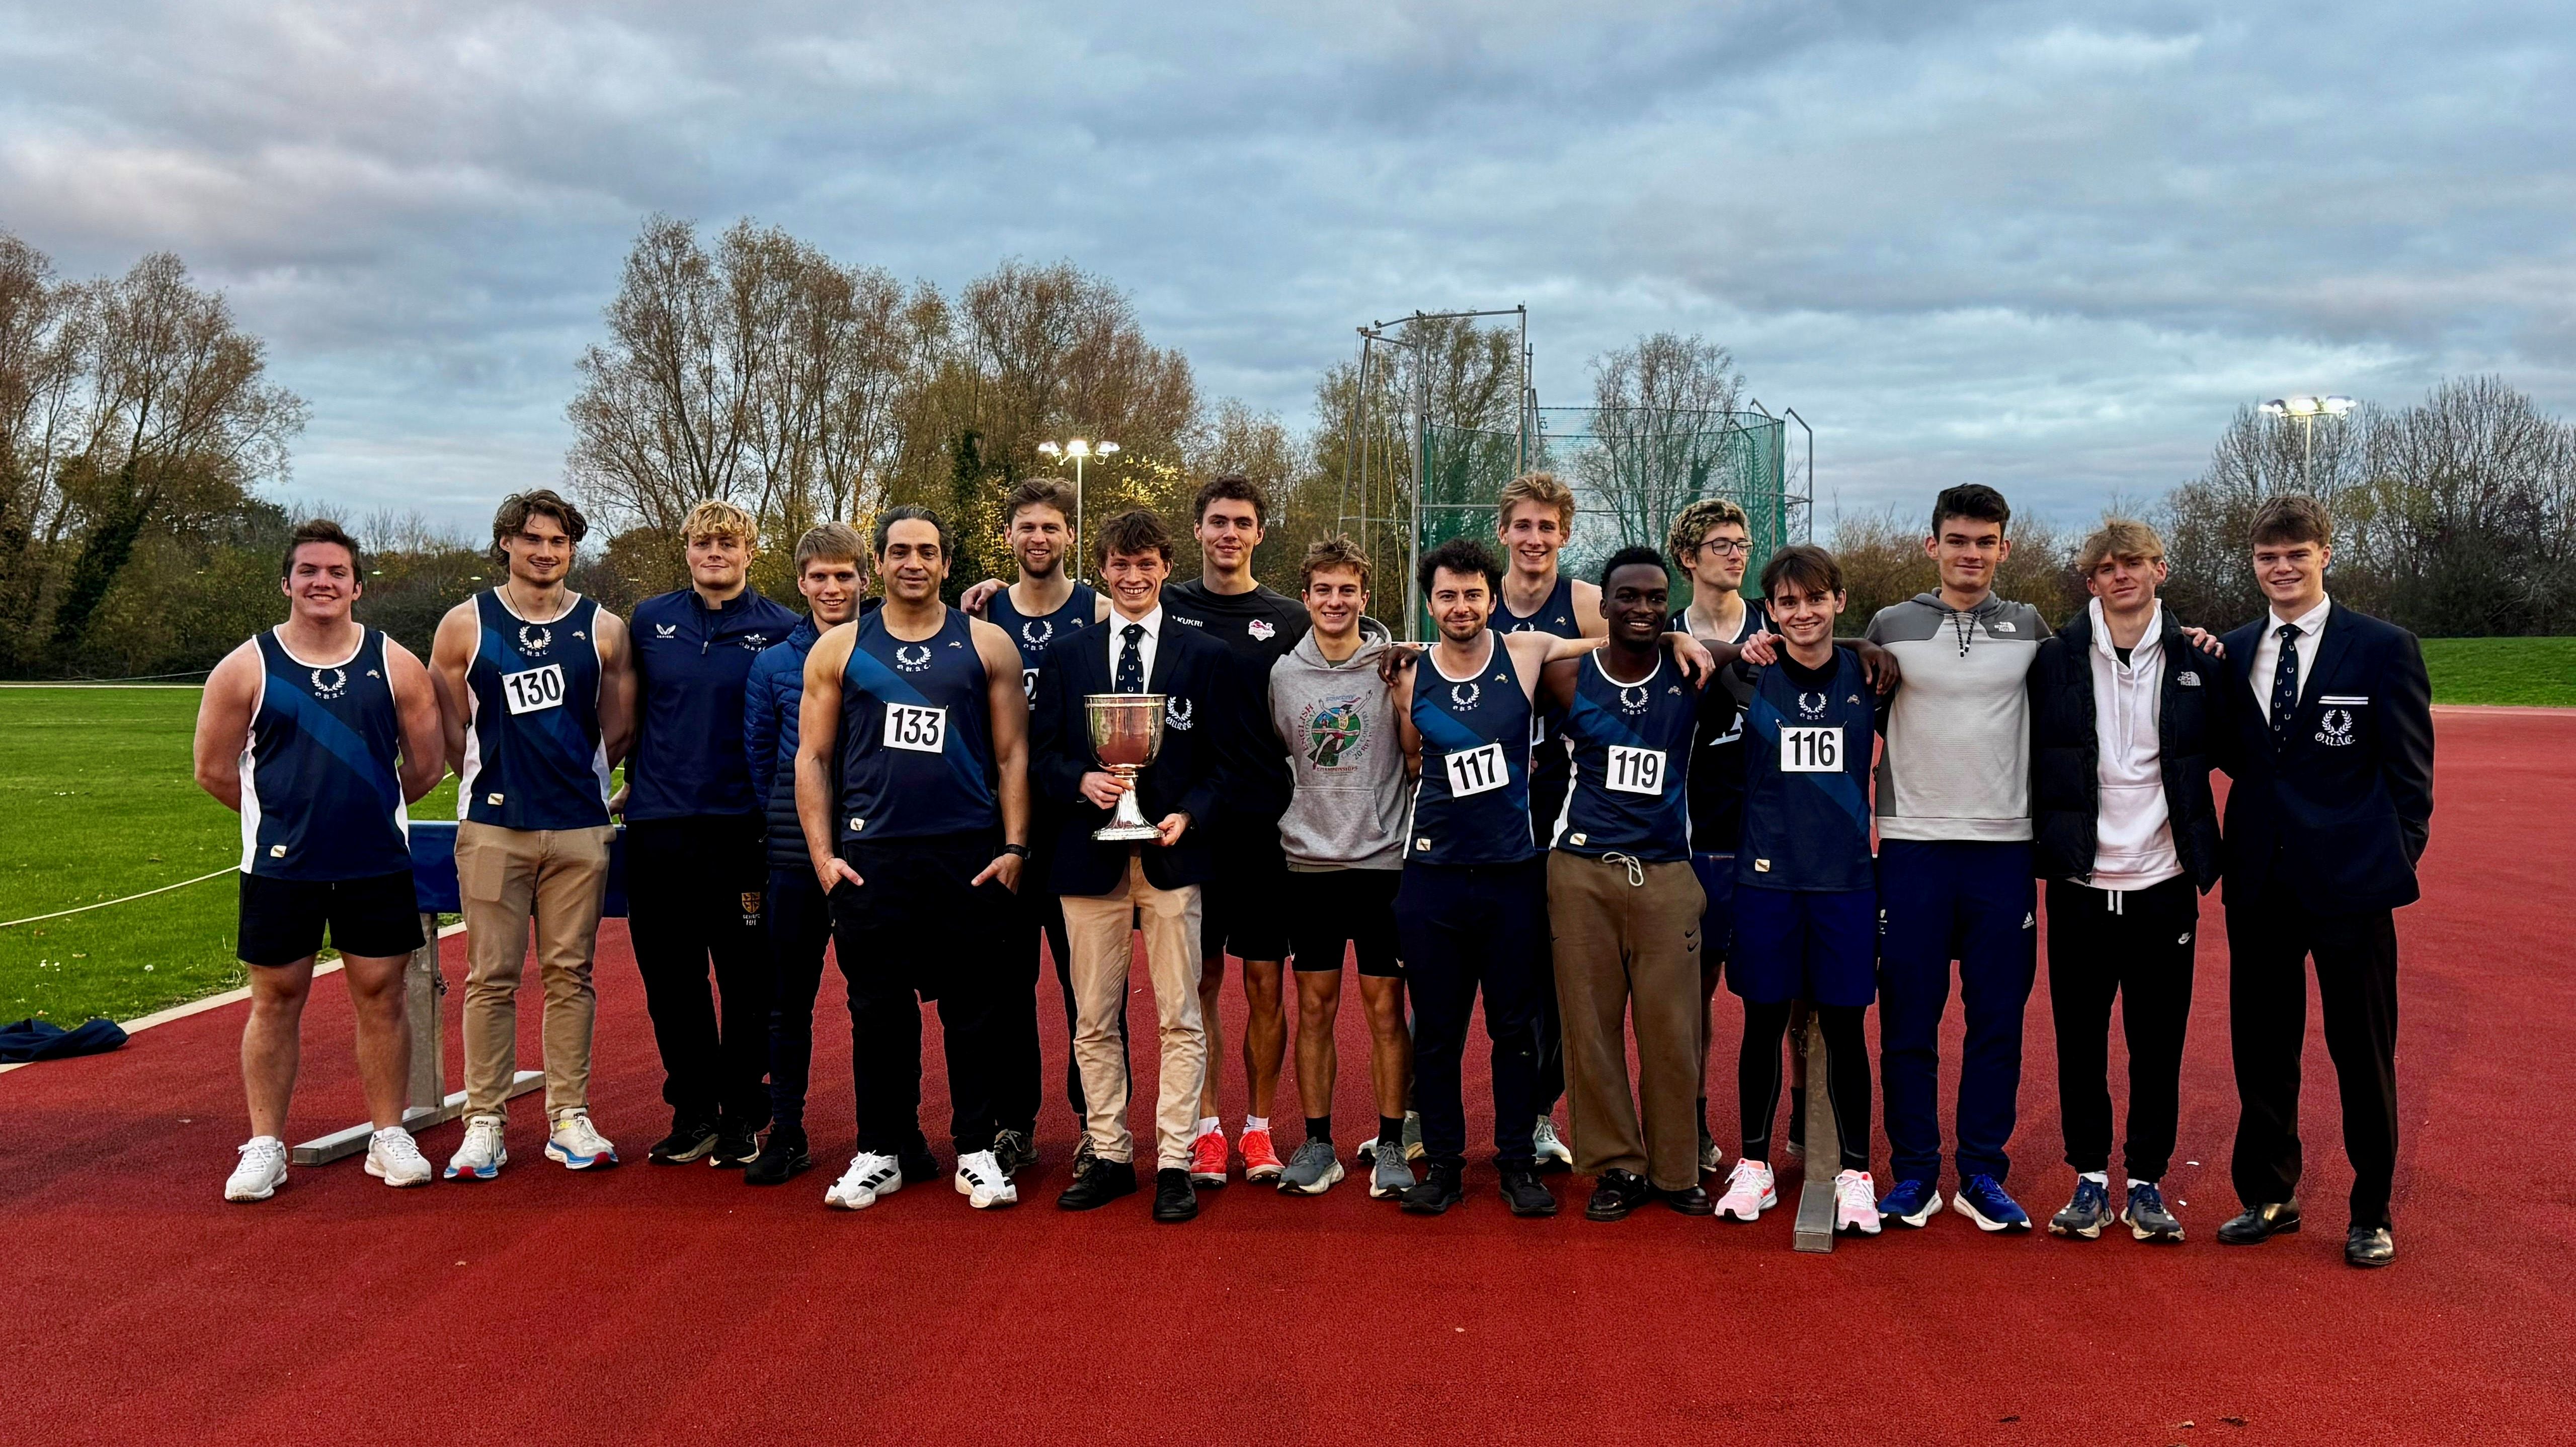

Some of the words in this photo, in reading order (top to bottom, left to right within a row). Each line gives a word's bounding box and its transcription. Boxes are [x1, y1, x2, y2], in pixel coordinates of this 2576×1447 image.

[1177, 616, 1203, 627] KUKRI
[510, 669, 560, 707] 130
[892, 707, 940, 746] 133
[1298, 703, 1314, 752] ENGLISH
[1789, 731, 1835, 767] 116
[1453, 747, 1496, 790] 117
[1615, 750, 1658, 788] 119
